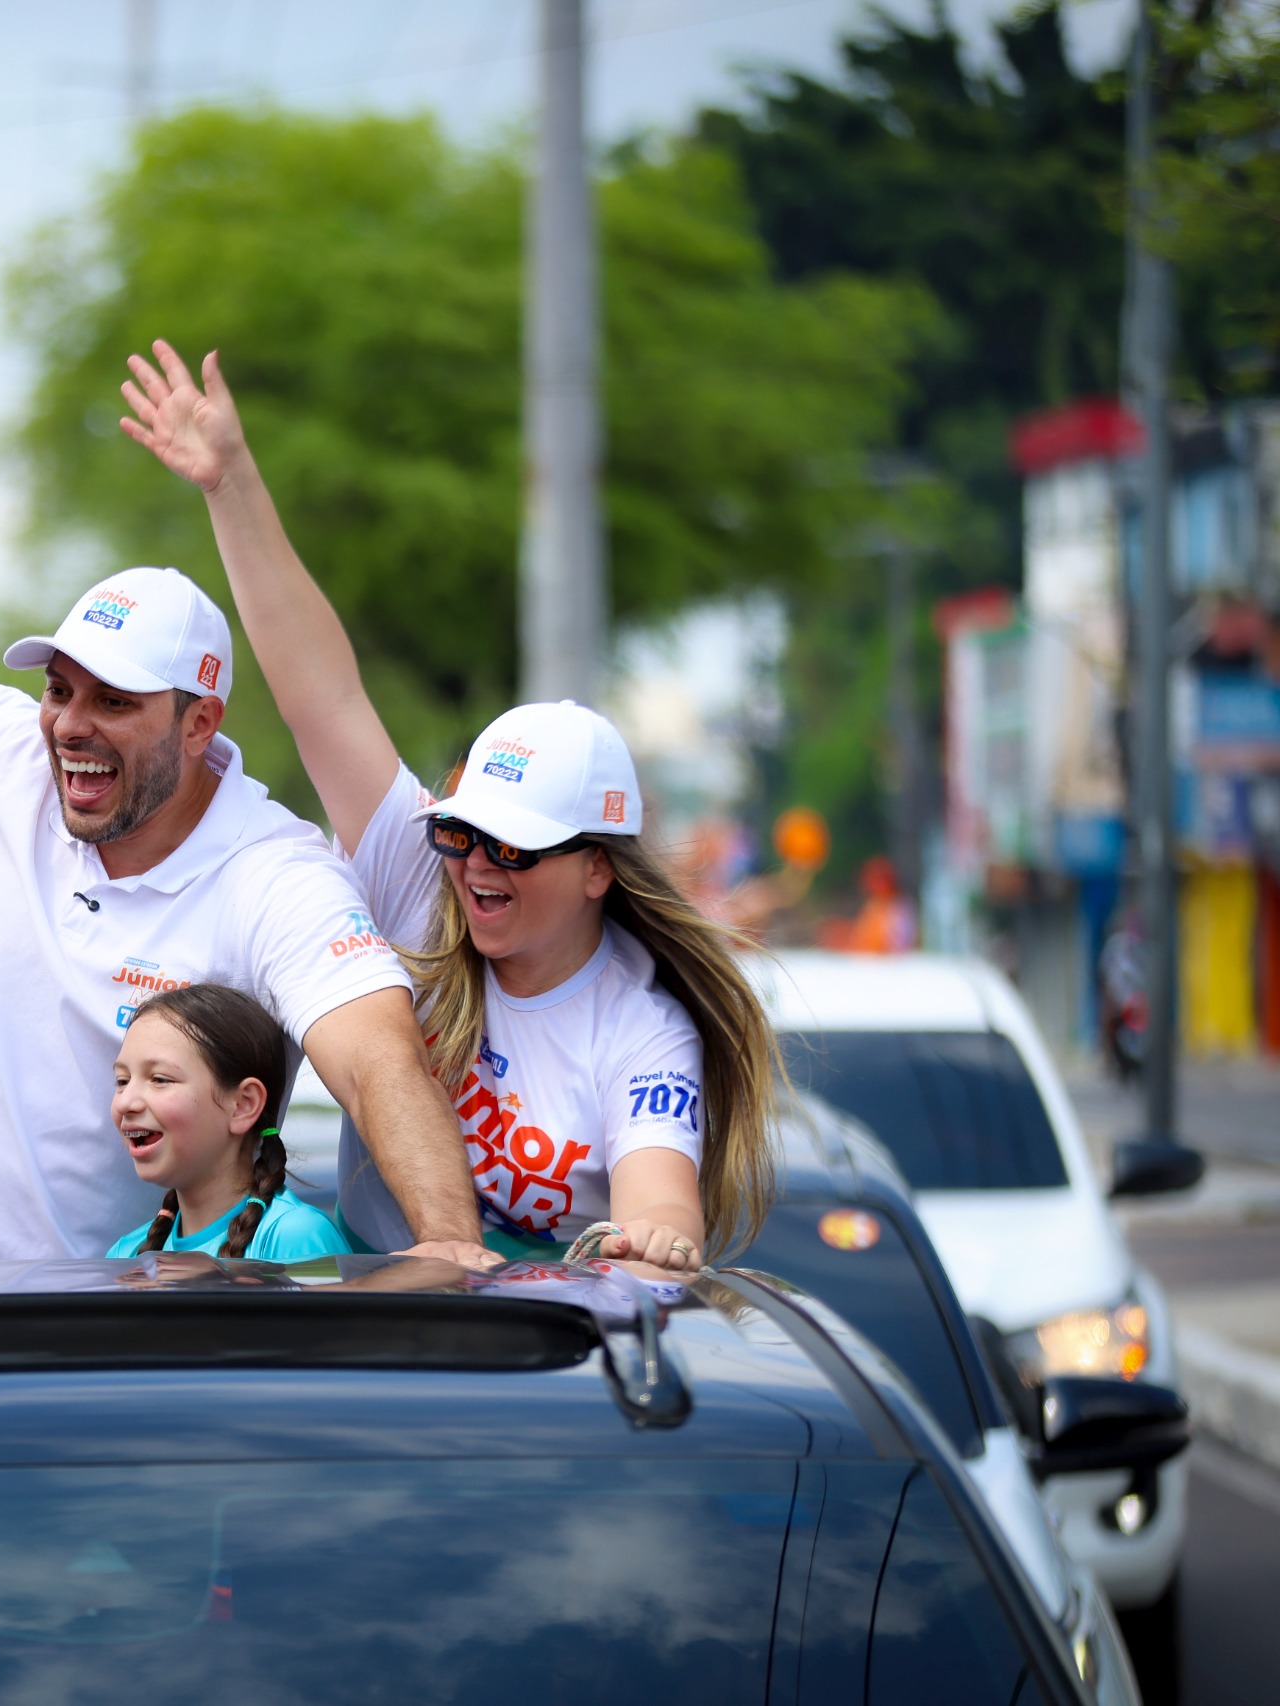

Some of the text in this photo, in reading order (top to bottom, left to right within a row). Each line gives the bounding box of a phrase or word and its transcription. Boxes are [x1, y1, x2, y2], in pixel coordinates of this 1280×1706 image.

[90, 600, 130, 619] MAR
[88, 612, 119, 627] 70222
[203, 656, 217, 675] 70
[488, 751, 529, 770] MAR
[486, 764, 519, 780] 70222
[434, 827, 468, 850] DAVID
[497, 842, 518, 860] 70
[629, 1071, 663, 1084] Aryel
